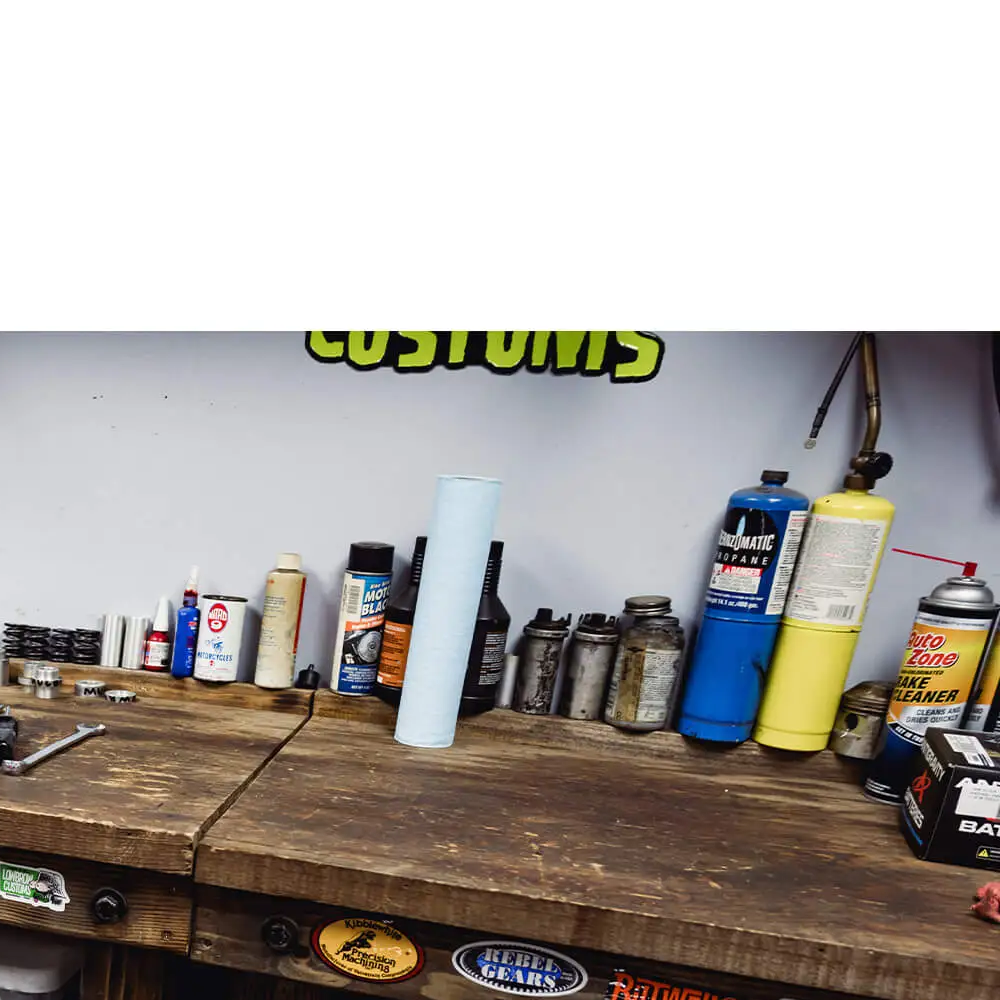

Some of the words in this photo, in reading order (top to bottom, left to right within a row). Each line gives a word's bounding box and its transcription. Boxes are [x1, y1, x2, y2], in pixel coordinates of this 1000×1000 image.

[716, 551, 769, 566] ROPANE
[364, 587, 389, 602] MOT
[906, 649, 958, 667] Zone
[4, 881, 31, 895] CUSTOMS
[342, 953, 390, 973] Machining
[352, 948, 396, 967] Precision
[484, 949, 558, 973] REBEL
[480, 964, 556, 989] GEARS
